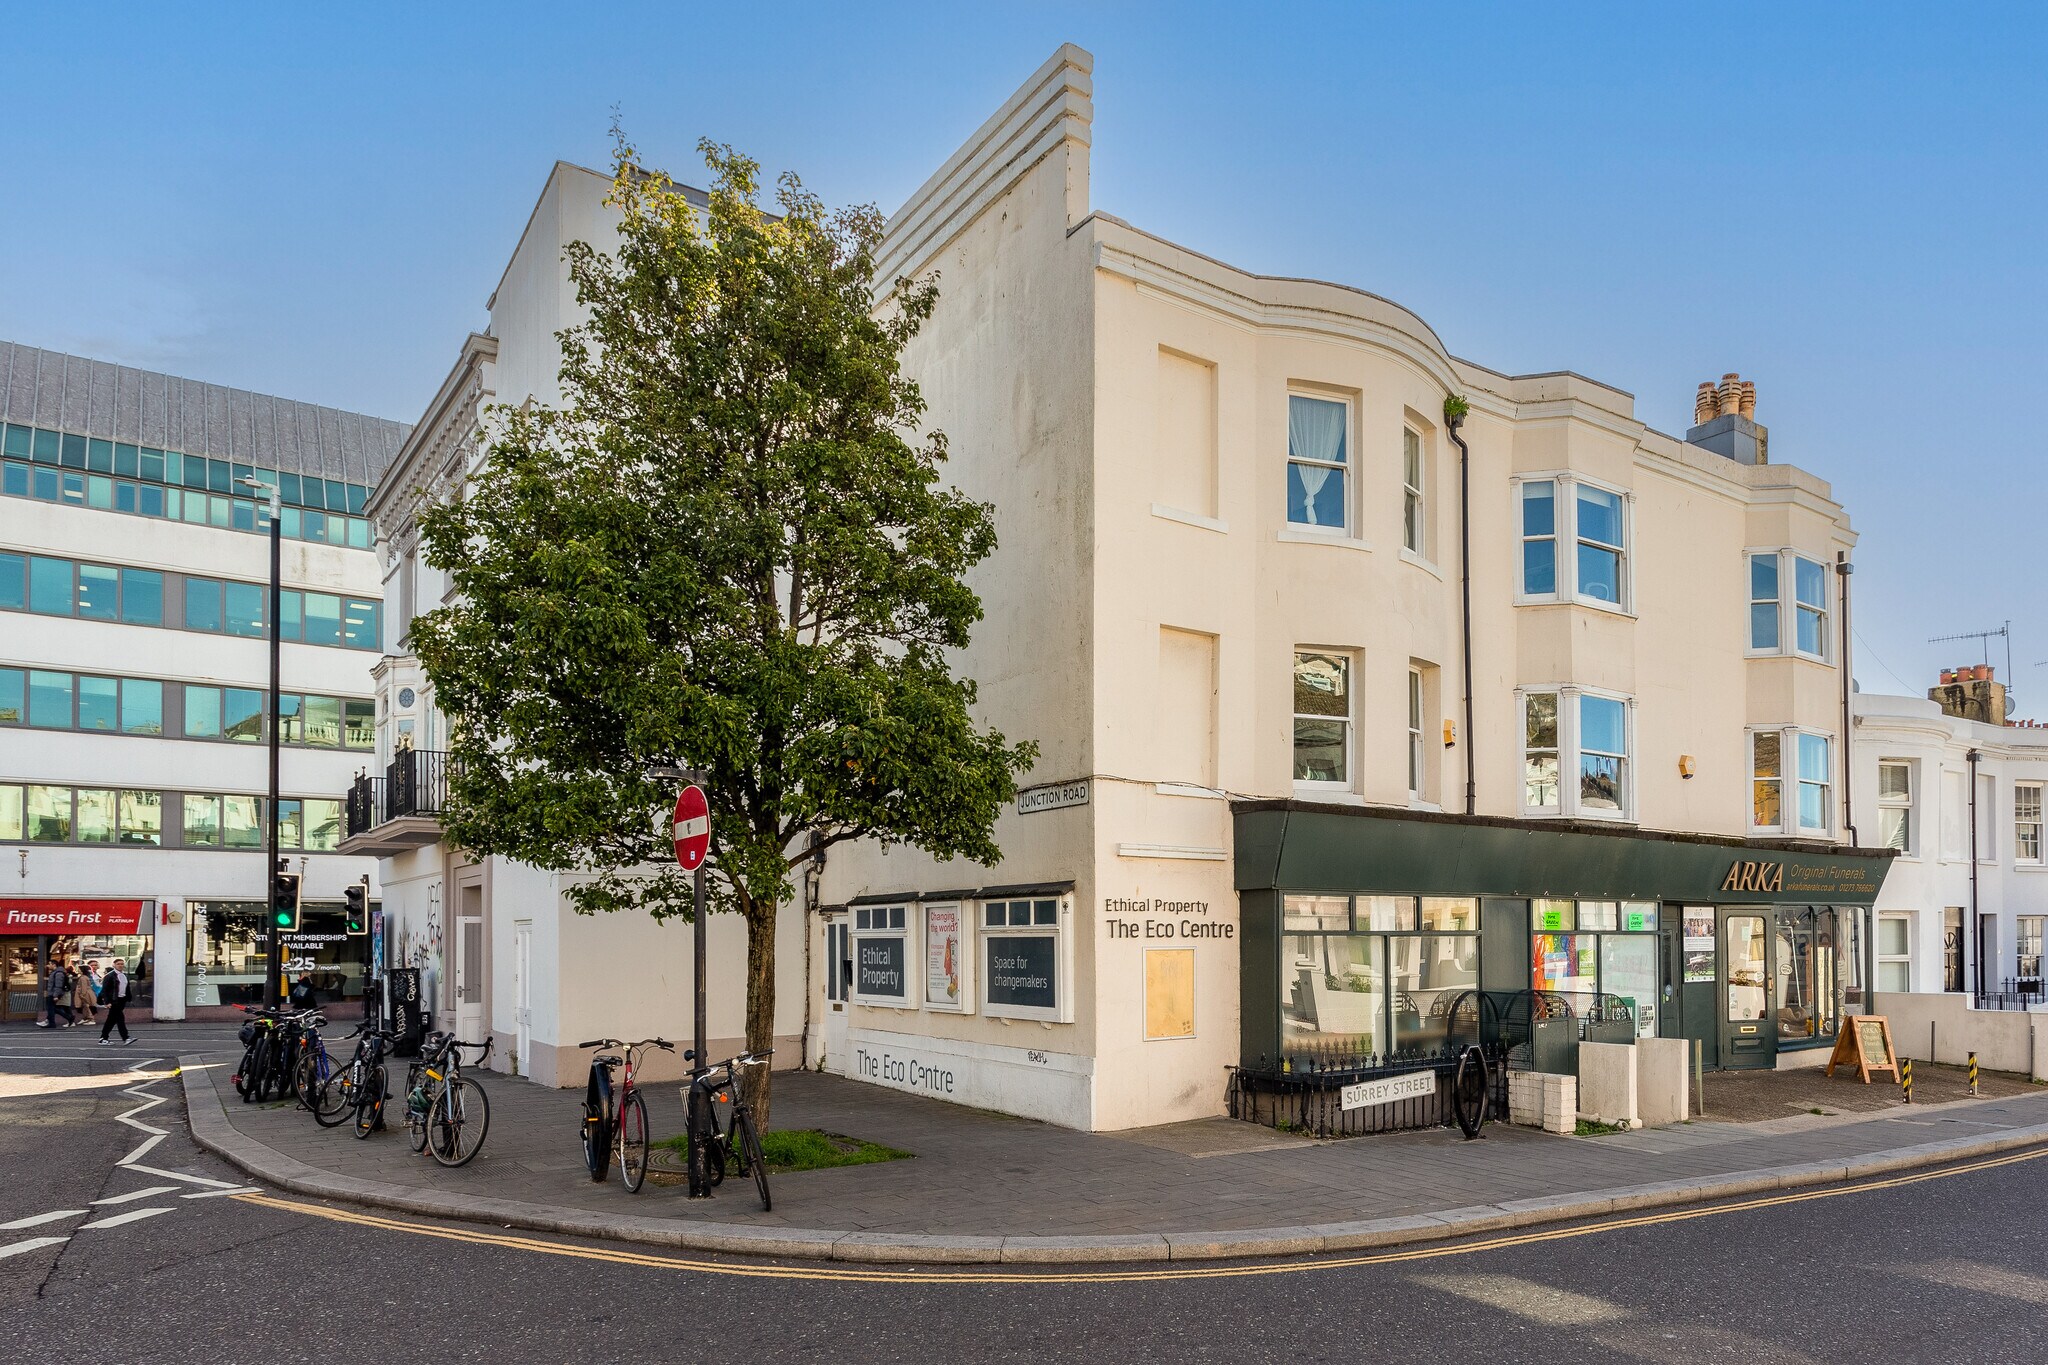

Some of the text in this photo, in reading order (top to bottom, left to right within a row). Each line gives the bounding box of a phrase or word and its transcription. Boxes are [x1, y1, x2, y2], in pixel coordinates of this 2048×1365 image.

[1020, 786, 1086, 808] JUNCTION ROAD
[1720, 860, 1866, 892] ARKA Original Funerals
[1105, 898, 1209, 915] Ethical Property
[7, 910, 102, 925] Fitness First
[930, 911, 955, 922] Changing
[930, 922, 958, 932] the world?
[1106, 919, 1234, 939] The Eco Centre
[862, 947, 891, 965] Ethical
[994, 955, 1028, 971] Space for
[197, 963, 208, 985] your
[862, 967, 899, 990] Property
[994, 973, 1048, 990] changemakers
[195, 987, 206, 1003] Put
[857, 1049, 954, 1093] The Eco Centre
[1346, 1076, 1431, 1104] SURREY STREET
